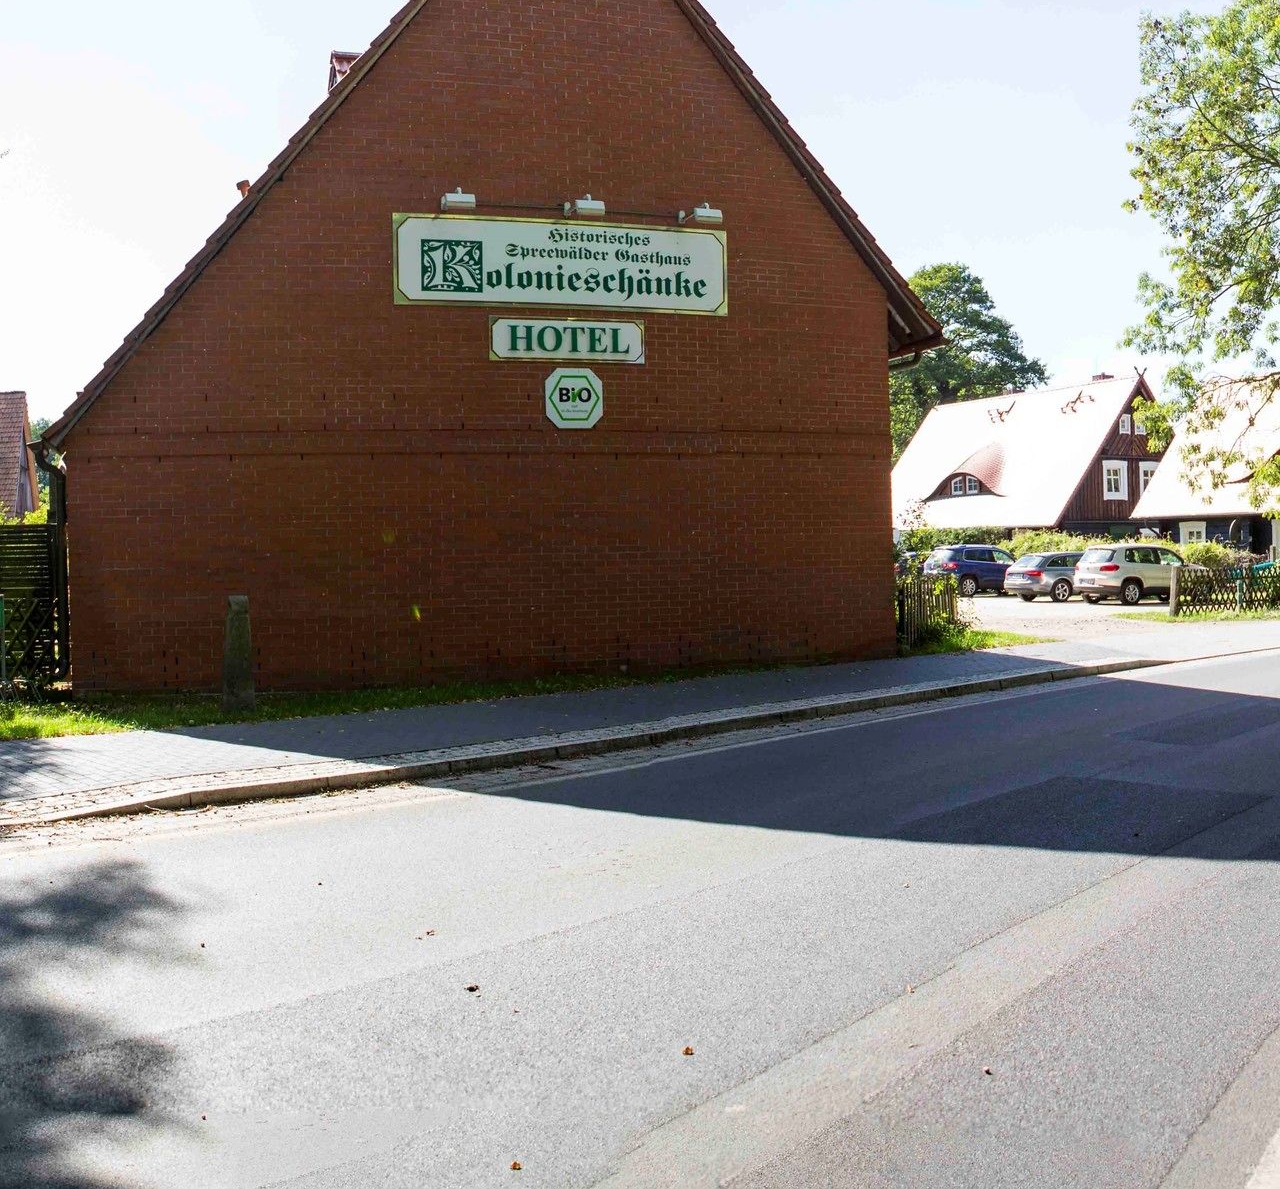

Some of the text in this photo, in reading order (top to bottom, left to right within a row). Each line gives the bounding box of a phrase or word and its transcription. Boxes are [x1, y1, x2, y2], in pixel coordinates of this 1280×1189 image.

[548, 227, 651, 247] Historisches
[505, 243, 691, 268] Spreewälder Gasthaus
[421, 239, 708, 301] Kolonieschänke
[508, 324, 630, 355] HOTEL
